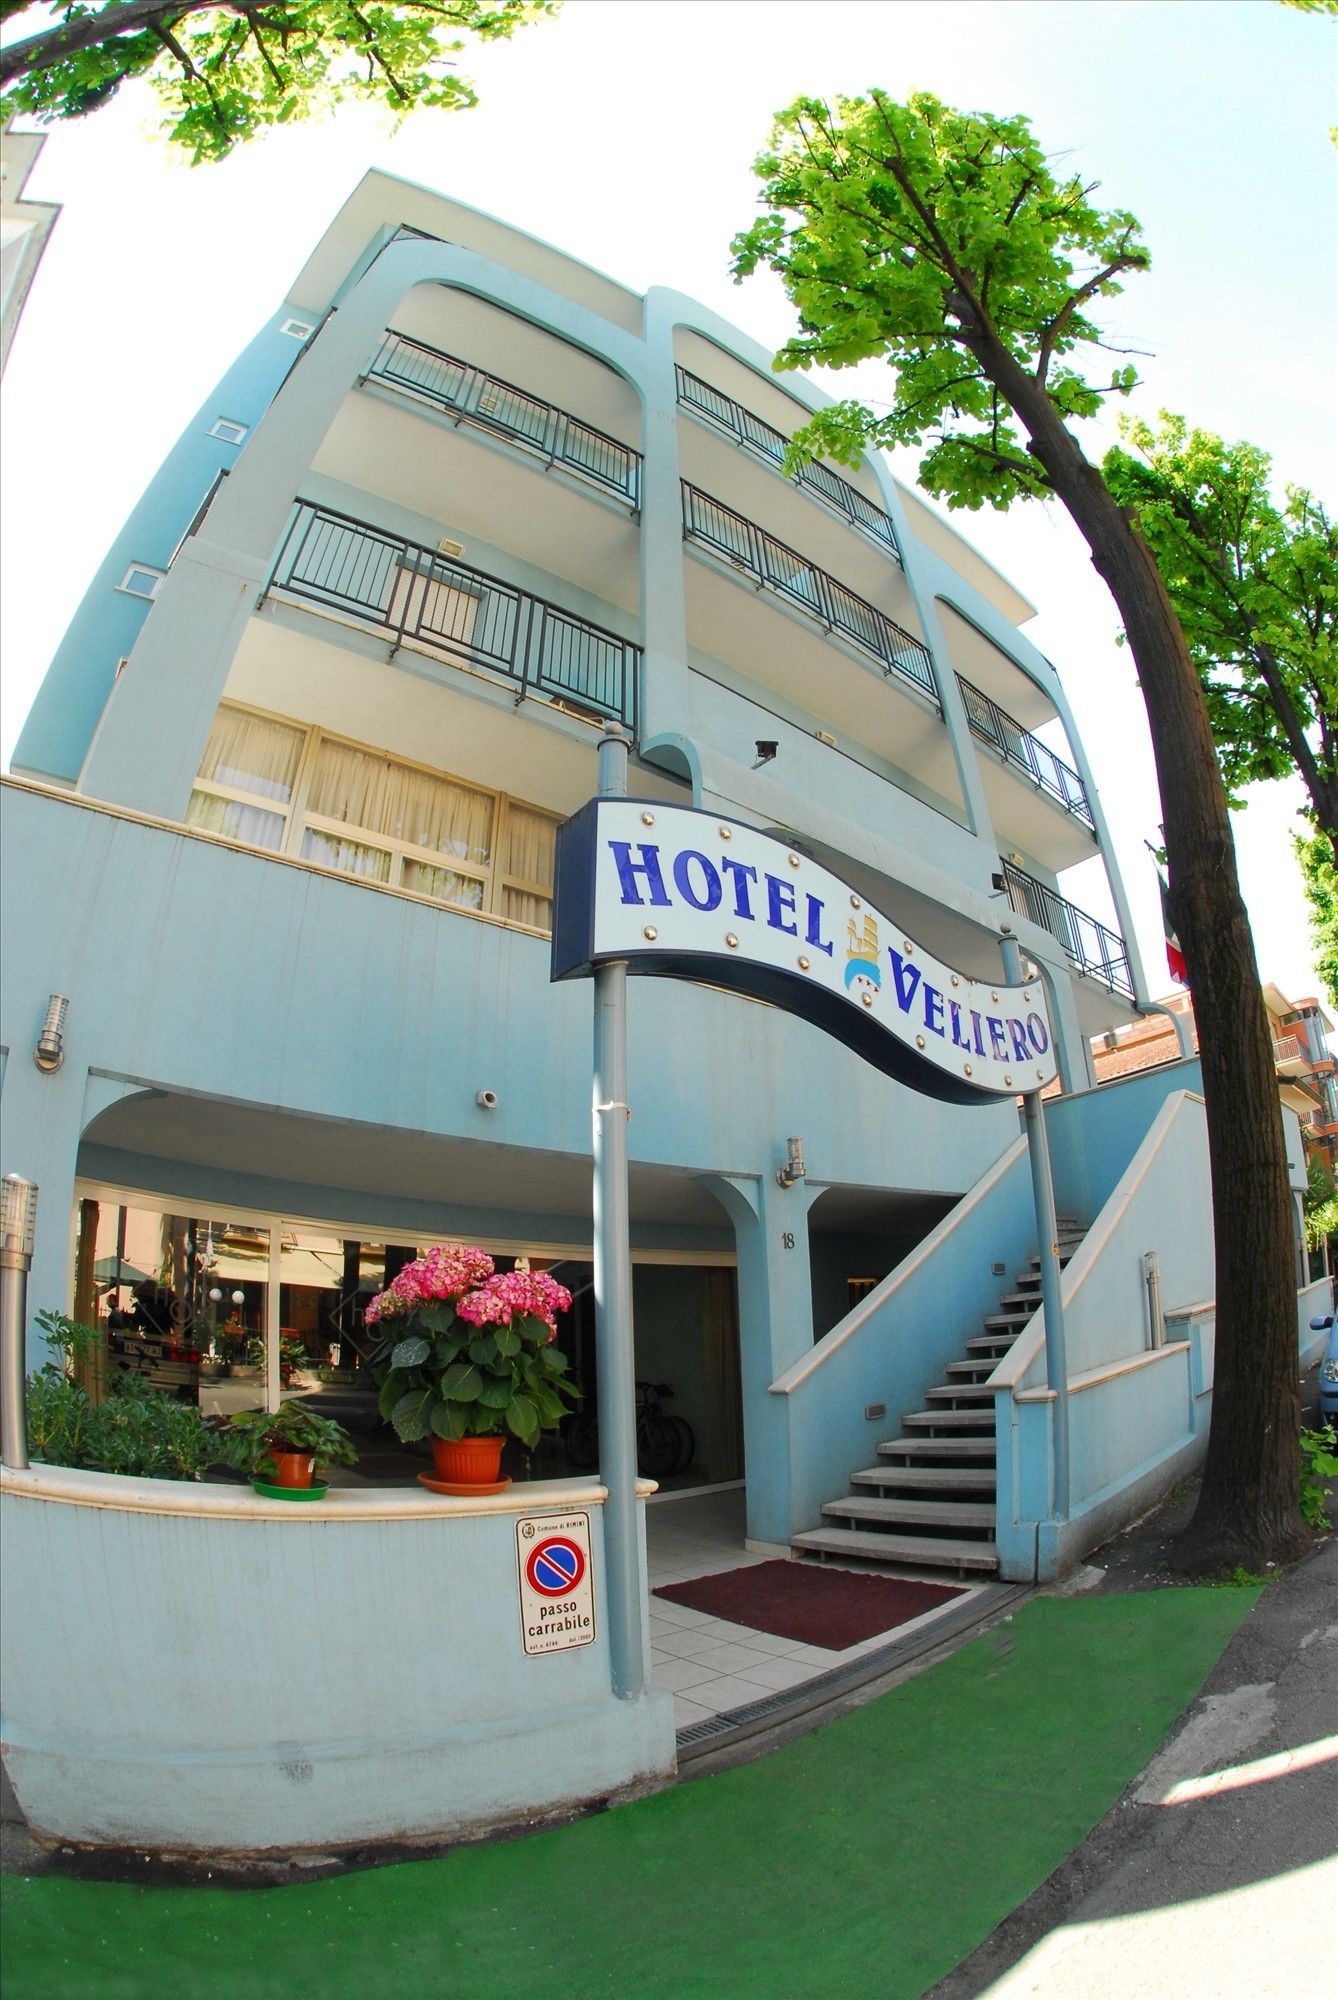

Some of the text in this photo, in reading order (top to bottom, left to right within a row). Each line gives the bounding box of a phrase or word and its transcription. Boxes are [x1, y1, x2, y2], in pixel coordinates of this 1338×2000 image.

[607, 840, 1049, 1063] HOTEL VELIERO
[782, 1232, 795, 1249] 18
[537, 1524, 558, 1532] Comune
[566, 1520, 585, 1528] RIMINI
[540, 1601, 577, 1620] passo
[528, 1614, 590, 1637] carrabile
